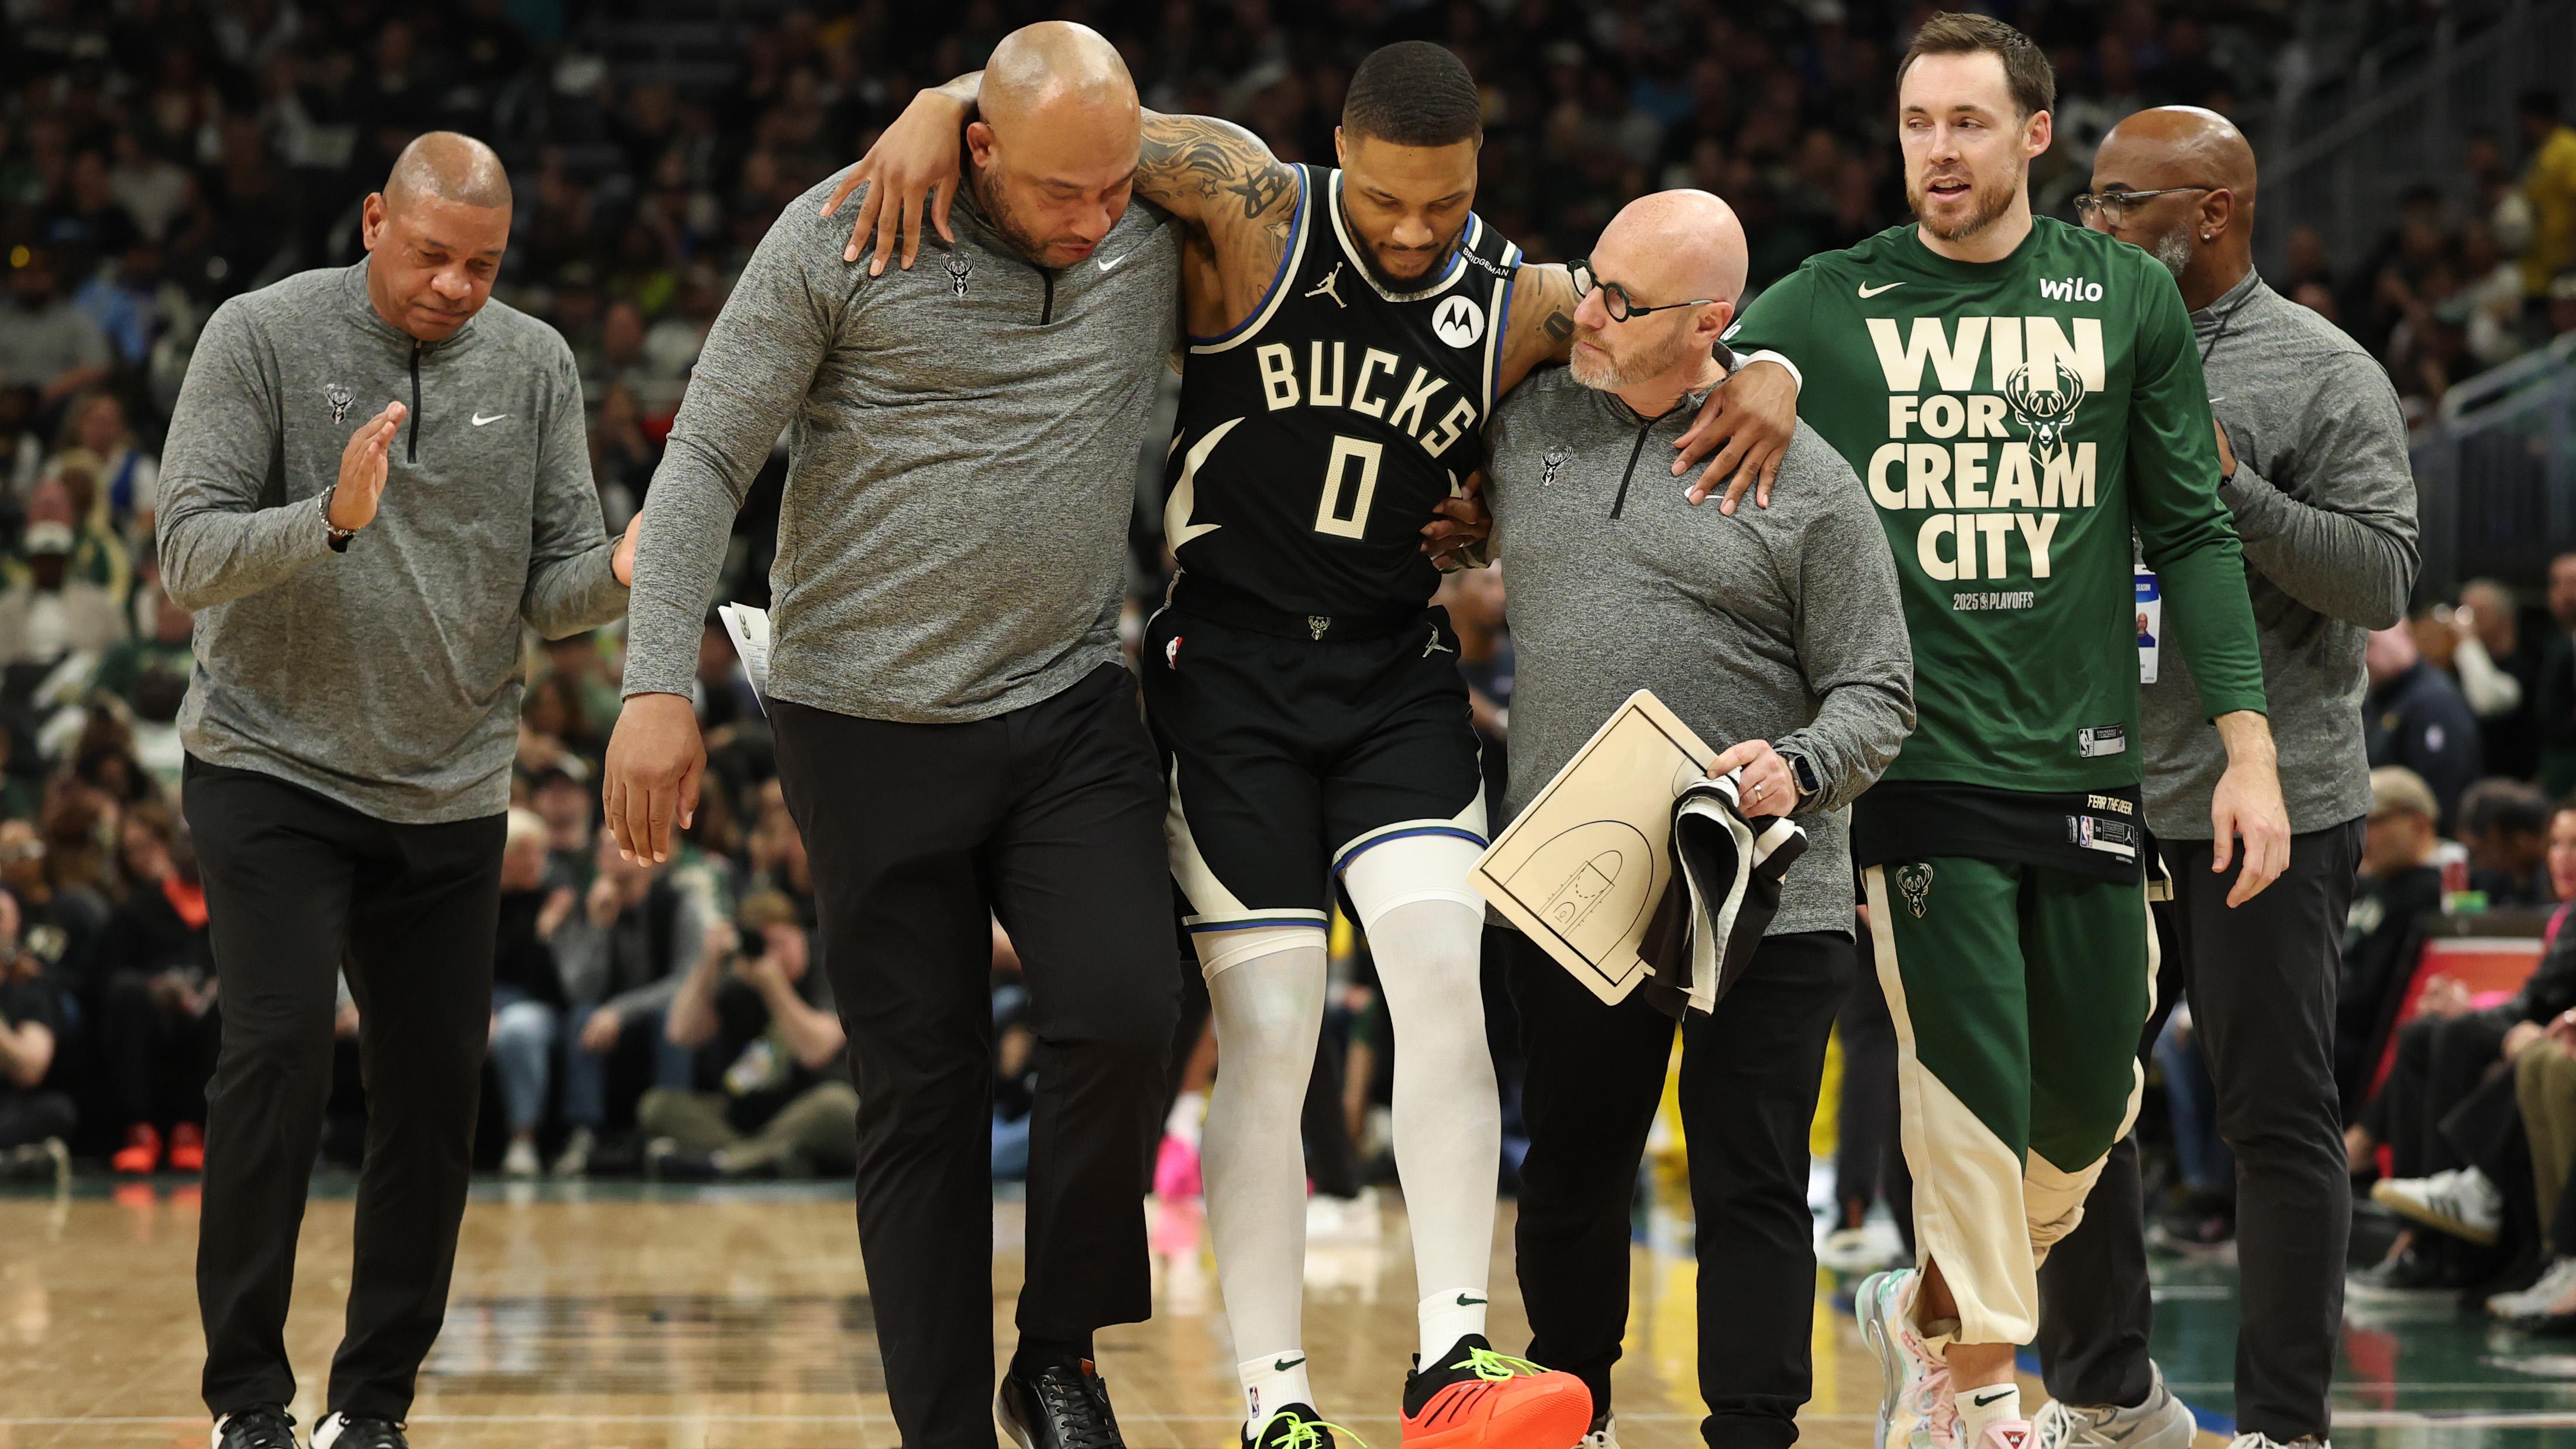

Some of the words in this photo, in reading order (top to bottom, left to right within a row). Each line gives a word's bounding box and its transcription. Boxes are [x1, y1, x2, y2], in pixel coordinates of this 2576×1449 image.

[1462, 247, 1509, 277] BRIDGEMAN
[2040, 277, 2103, 302] wilo
[1865, 316, 2106, 393] WIN
[1255, 339, 1478, 459] BUCKS
[1888, 394, 2010, 439] FOR
[1313, 434, 1385, 541] 0
[1867, 442, 2097, 510] CREAM
[1916, 512, 2061, 581] CITY
[1952, 593, 1979, 611] 2025
[1989, 591, 2034, 610] PLAYOFFS
[2087, 794, 2107, 810] FEAR
[2106, 797, 2120, 812] THE
[2117, 799, 2133, 816] DEER
